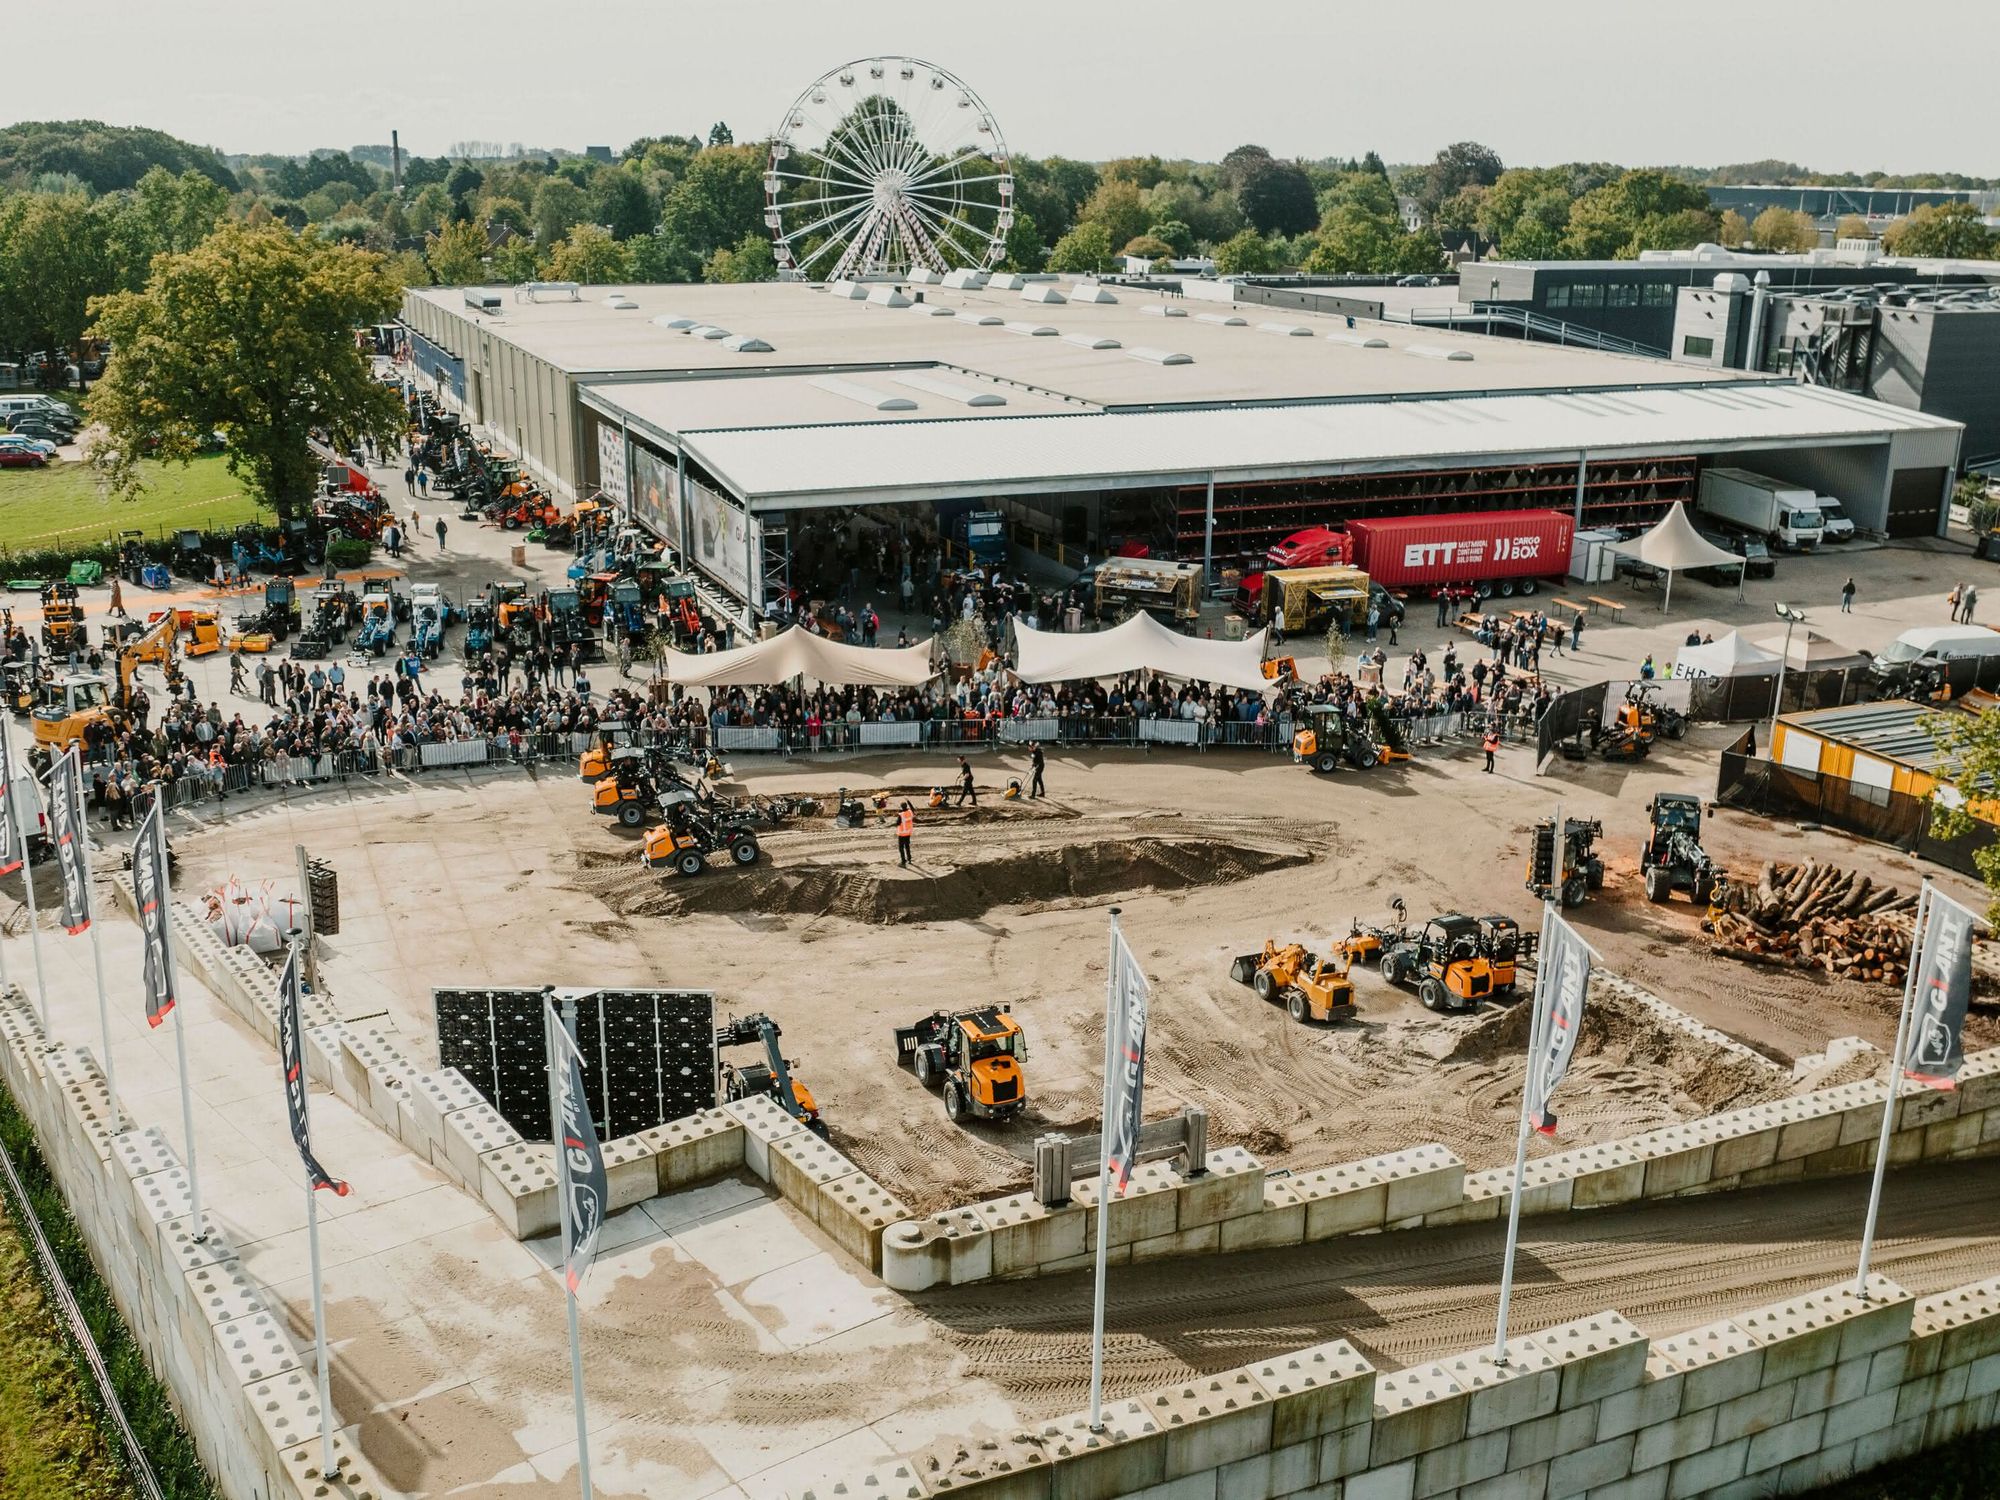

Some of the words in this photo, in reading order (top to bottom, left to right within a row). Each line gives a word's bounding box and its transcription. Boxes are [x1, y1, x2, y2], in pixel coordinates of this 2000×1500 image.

[1404, 542, 1457, 567] BTT
[1511, 545, 1539, 560] BOX
[1513, 536, 1540, 546] CARGO
[1928, 911, 1962, 1012] GIANT
[1551, 941, 1580, 1049] GIANT
[559, 1045, 593, 1174] GIANT
